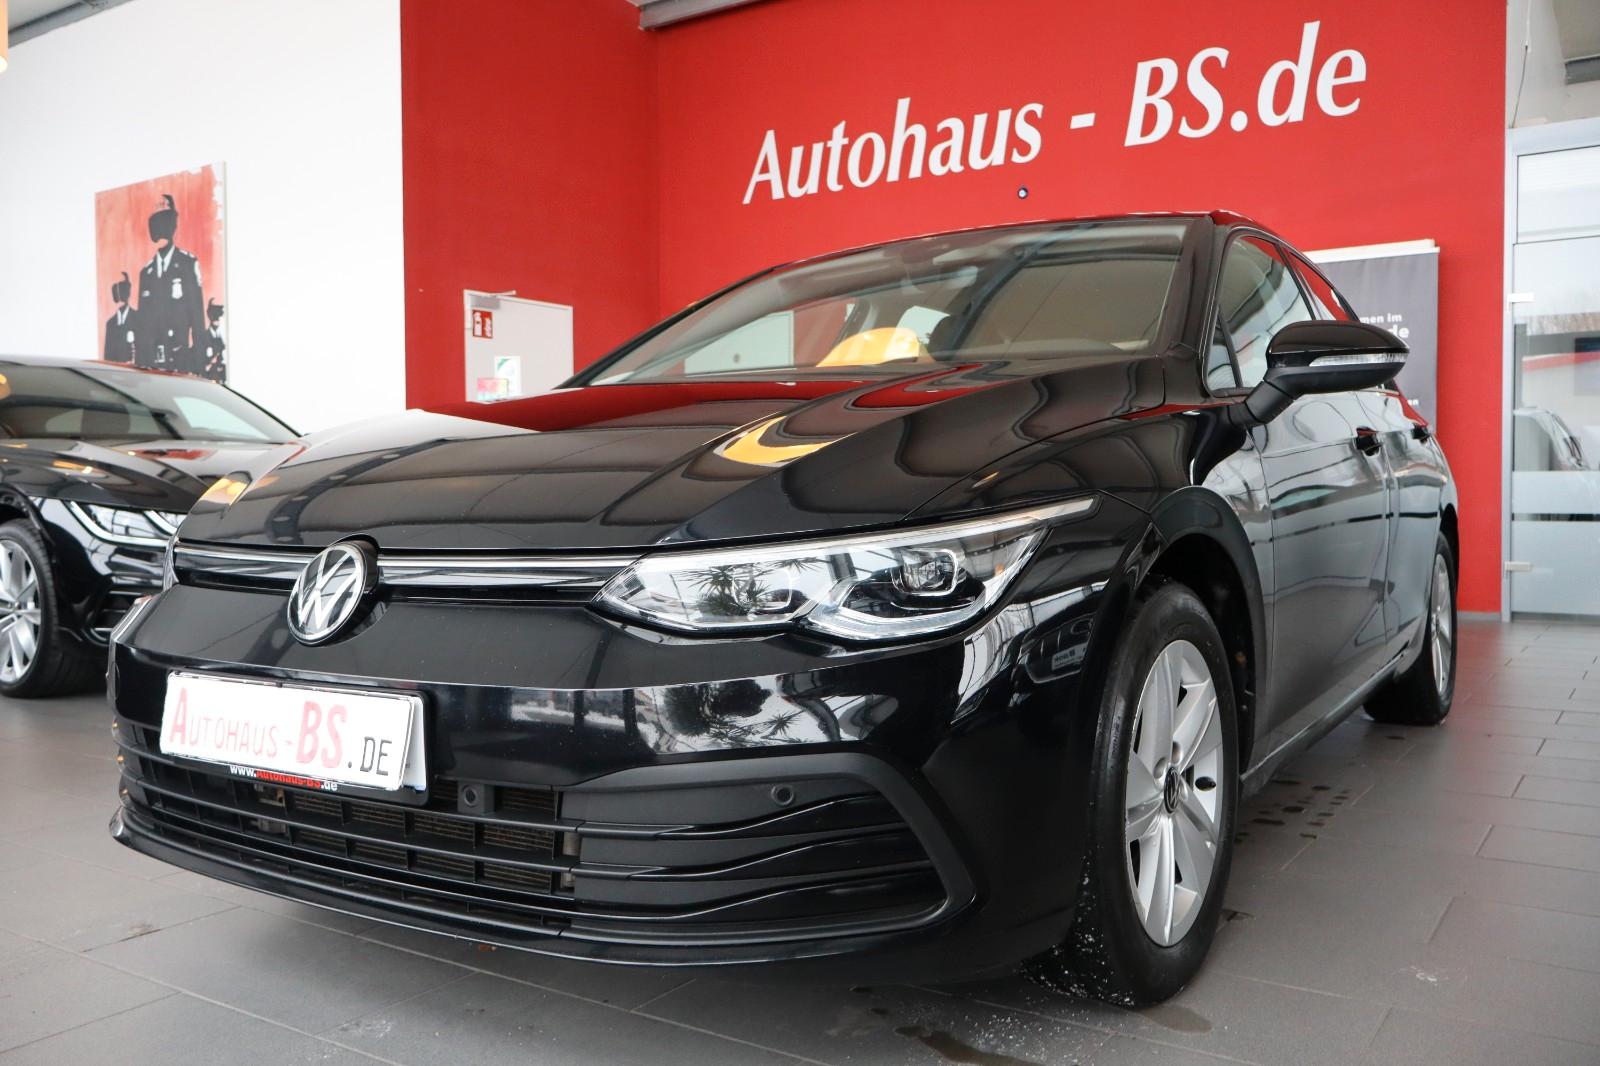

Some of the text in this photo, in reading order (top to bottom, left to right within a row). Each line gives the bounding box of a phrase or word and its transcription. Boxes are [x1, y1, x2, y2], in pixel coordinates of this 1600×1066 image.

[742, 20, 1367, 205] Autohaus - BS.de
[1387, 313, 1402, 323] im
